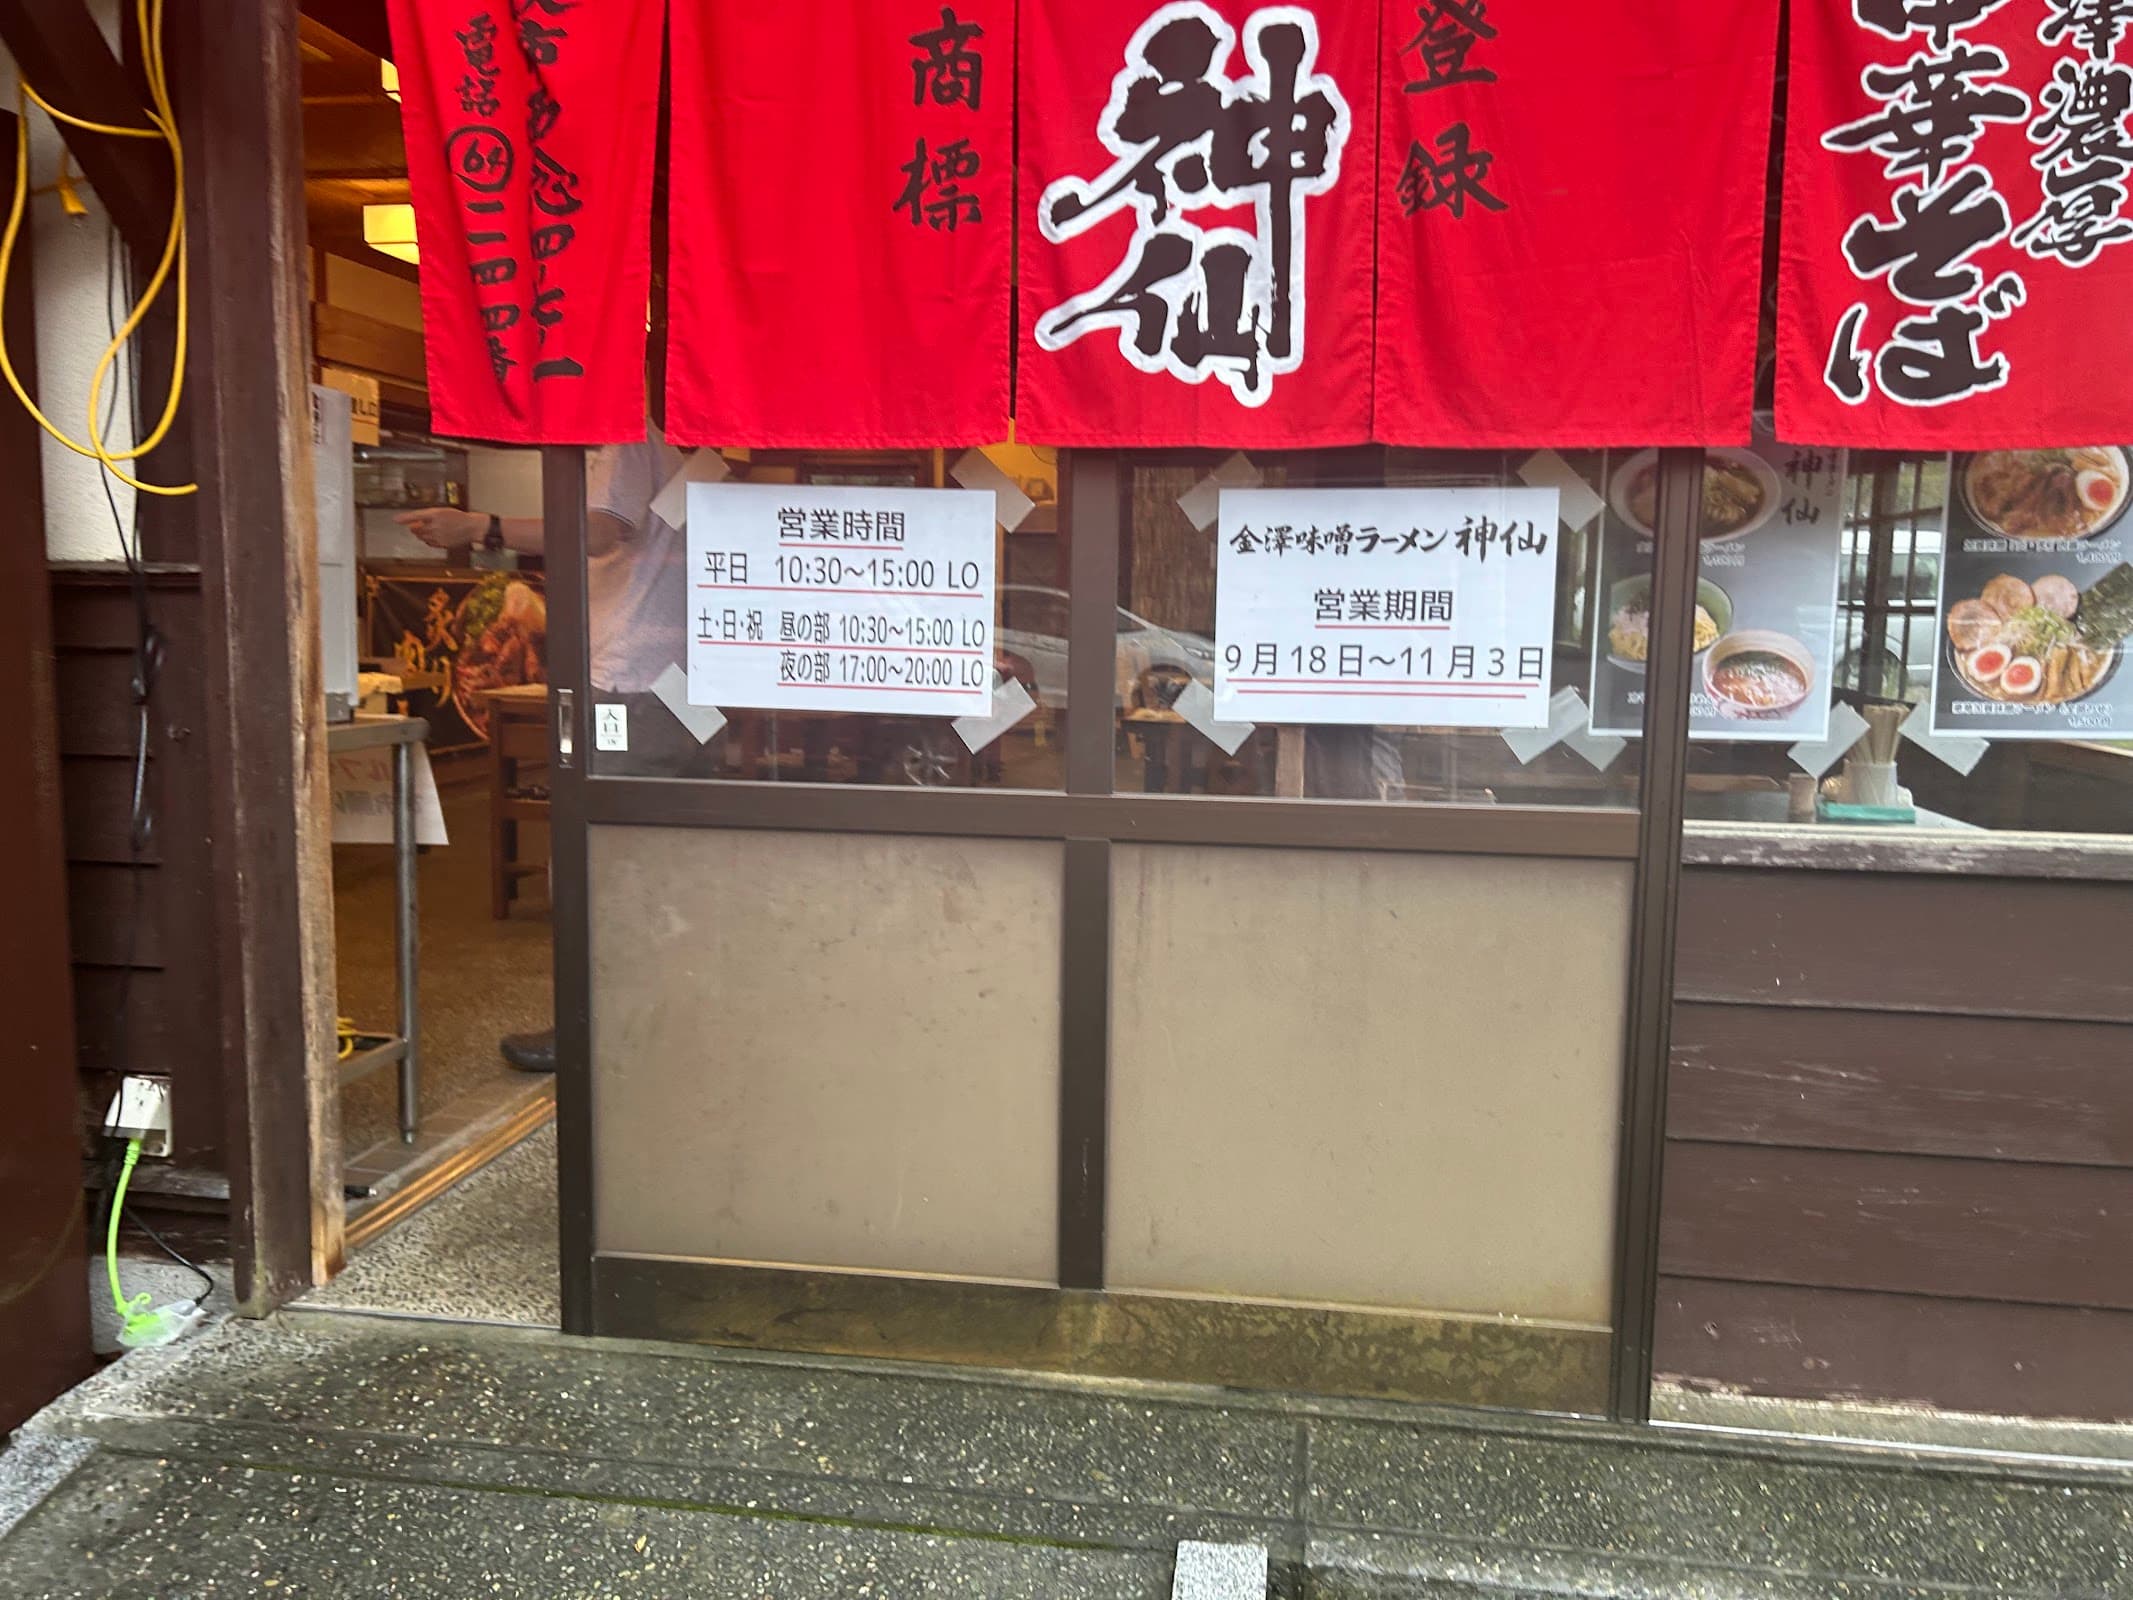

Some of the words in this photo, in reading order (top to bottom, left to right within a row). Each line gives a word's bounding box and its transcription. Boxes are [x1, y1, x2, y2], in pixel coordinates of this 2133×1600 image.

[893, 5, 985, 232] 商標
[1396, 0, 1509, 219] 登録
[1035, 0, 1351, 407] 神仙
[777, 507, 905, 542] 営業時間
[1228, 523, 1449, 558] 金澤味噌ラーメン
[1454, 515, 1549, 564] 神仙
[704, 551, 749, 585] 平日
[774, 555, 935, 588] 10:30～15:00
[947, 560, 980, 589] LO
[1314, 587, 1454, 623] 営業期間
[780, 610, 831, 644] 昼の部
[839, 615, 954, 646] 10:30～15:00
[962, 619, 986, 648] LO
[779, 649, 831, 684] 夜の部
[839, 655, 953, 687] 17:00～20:00
[961, 659, 985, 688] LO
